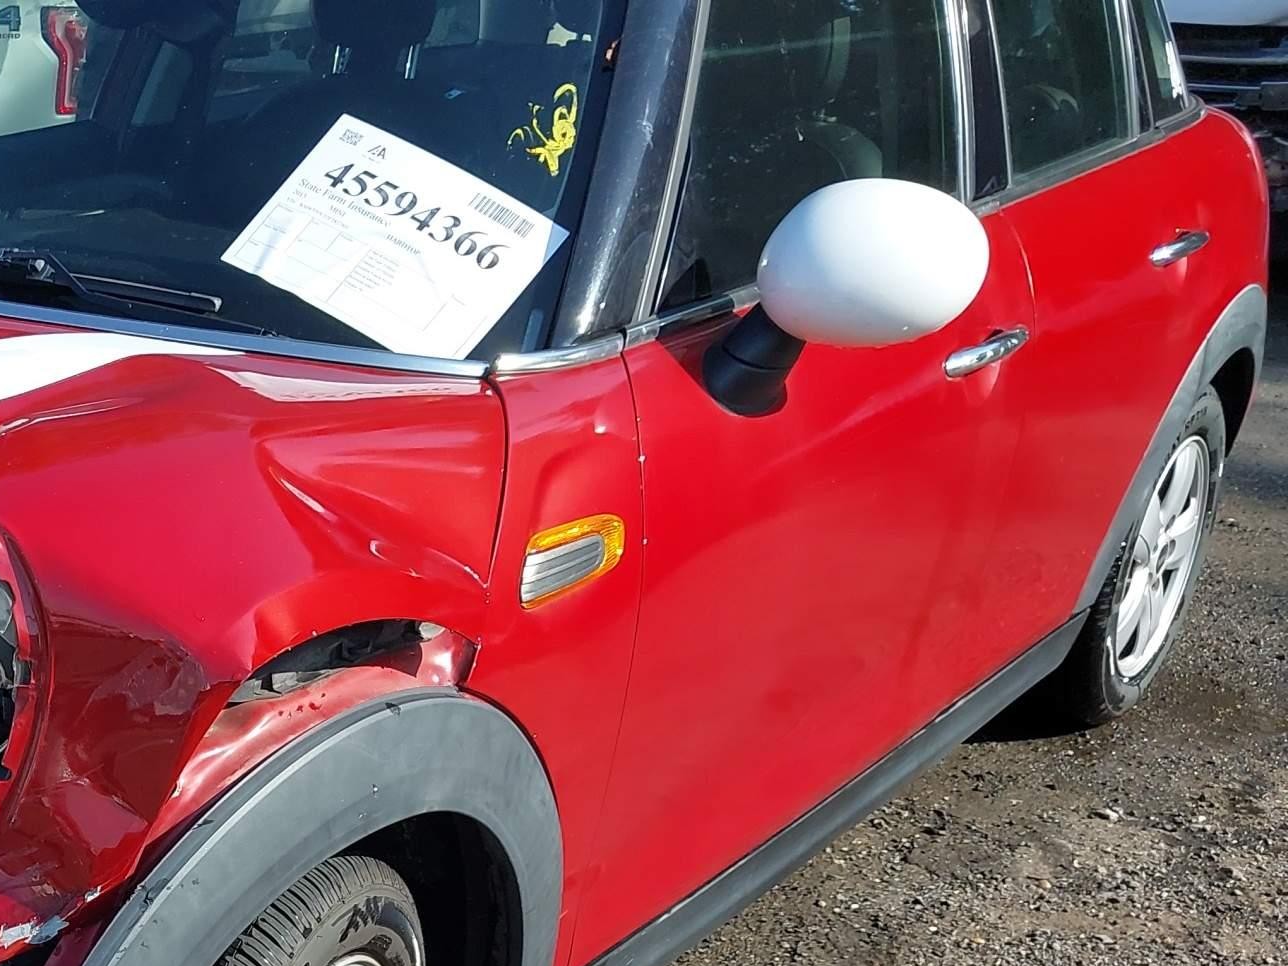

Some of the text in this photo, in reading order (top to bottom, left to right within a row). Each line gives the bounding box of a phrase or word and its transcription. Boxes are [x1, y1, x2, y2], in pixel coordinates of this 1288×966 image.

[298, 178, 322, 193] State
[322, 189, 347, 205] Farm
[324, 163, 511, 269] 45594366
